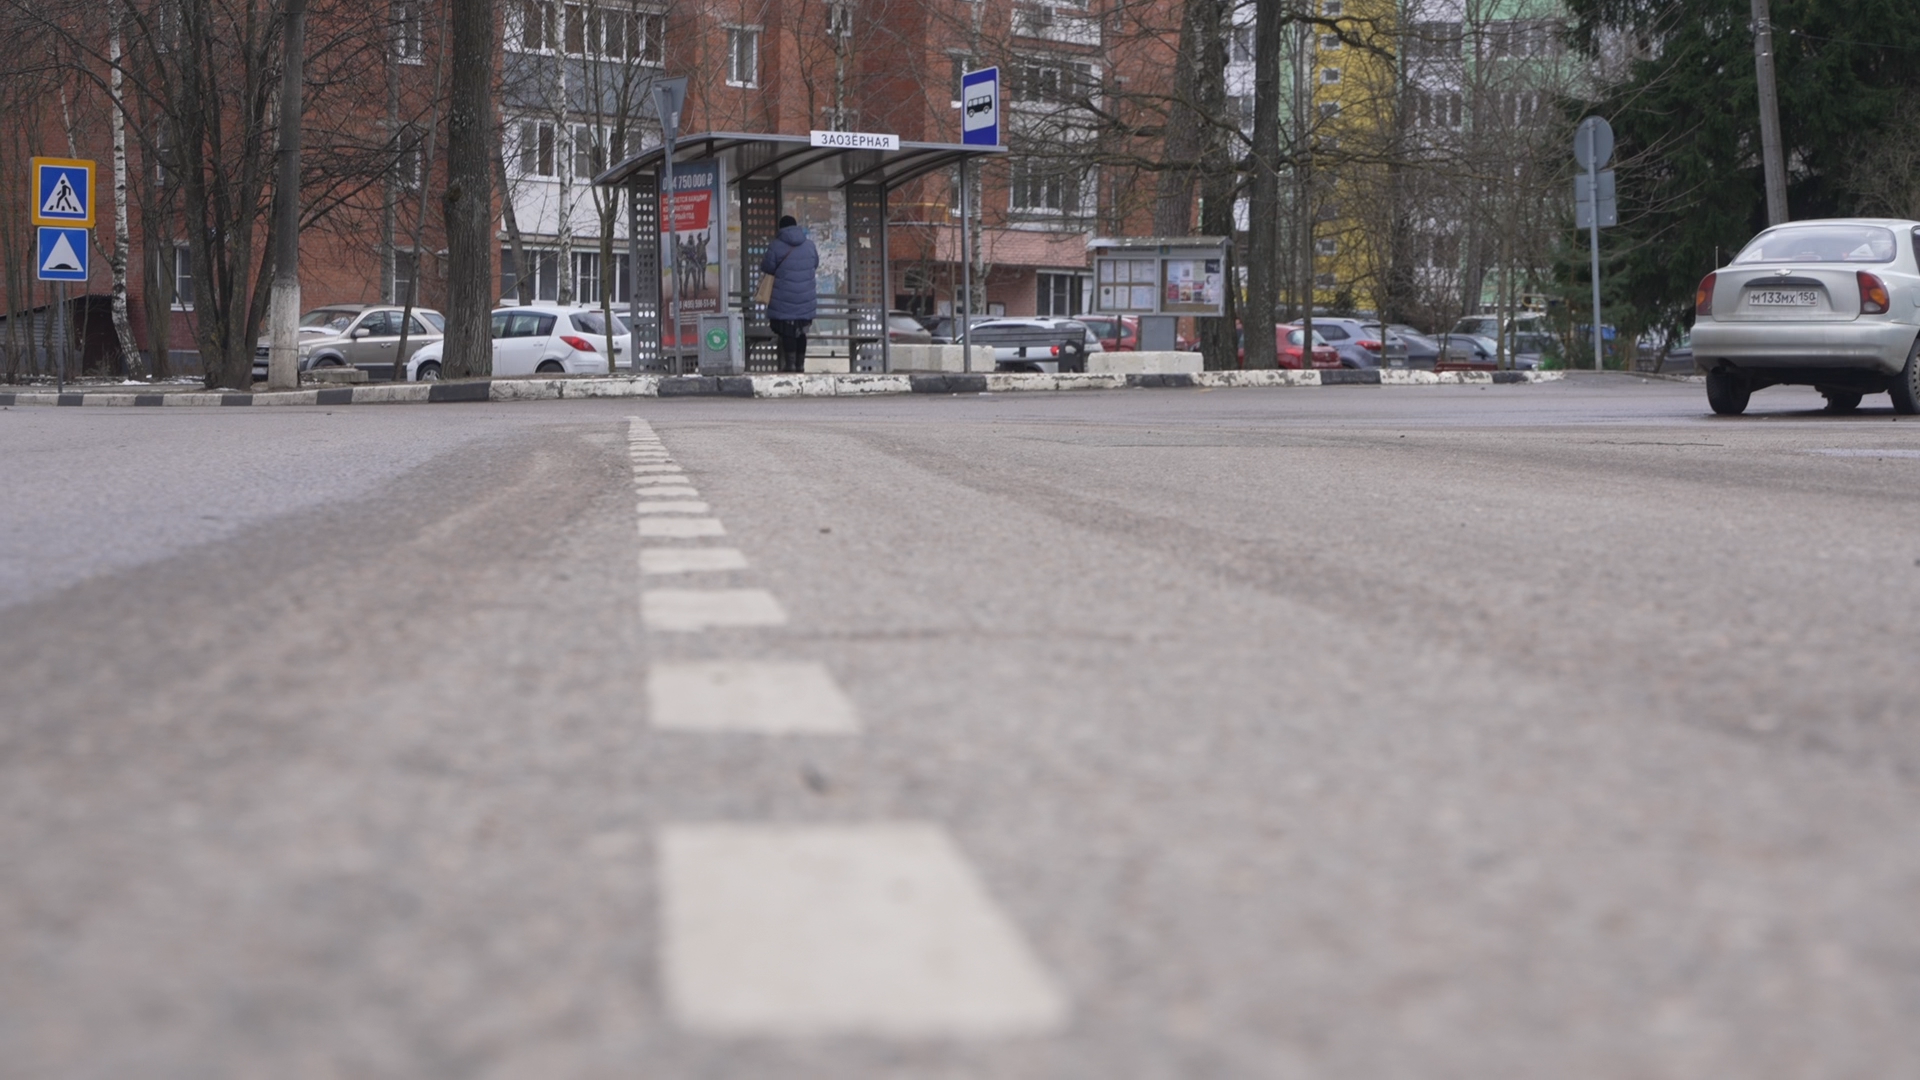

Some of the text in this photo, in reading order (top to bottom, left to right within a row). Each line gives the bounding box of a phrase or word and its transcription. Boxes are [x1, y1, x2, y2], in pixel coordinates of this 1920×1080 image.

[821, 133, 890, 148] ЗАОЗЁРНАЯ
[678, 175, 692, 189] 750
[692, 173, 706, 187] 000
[1751, 291, 1816, 304] М133МХ 150
